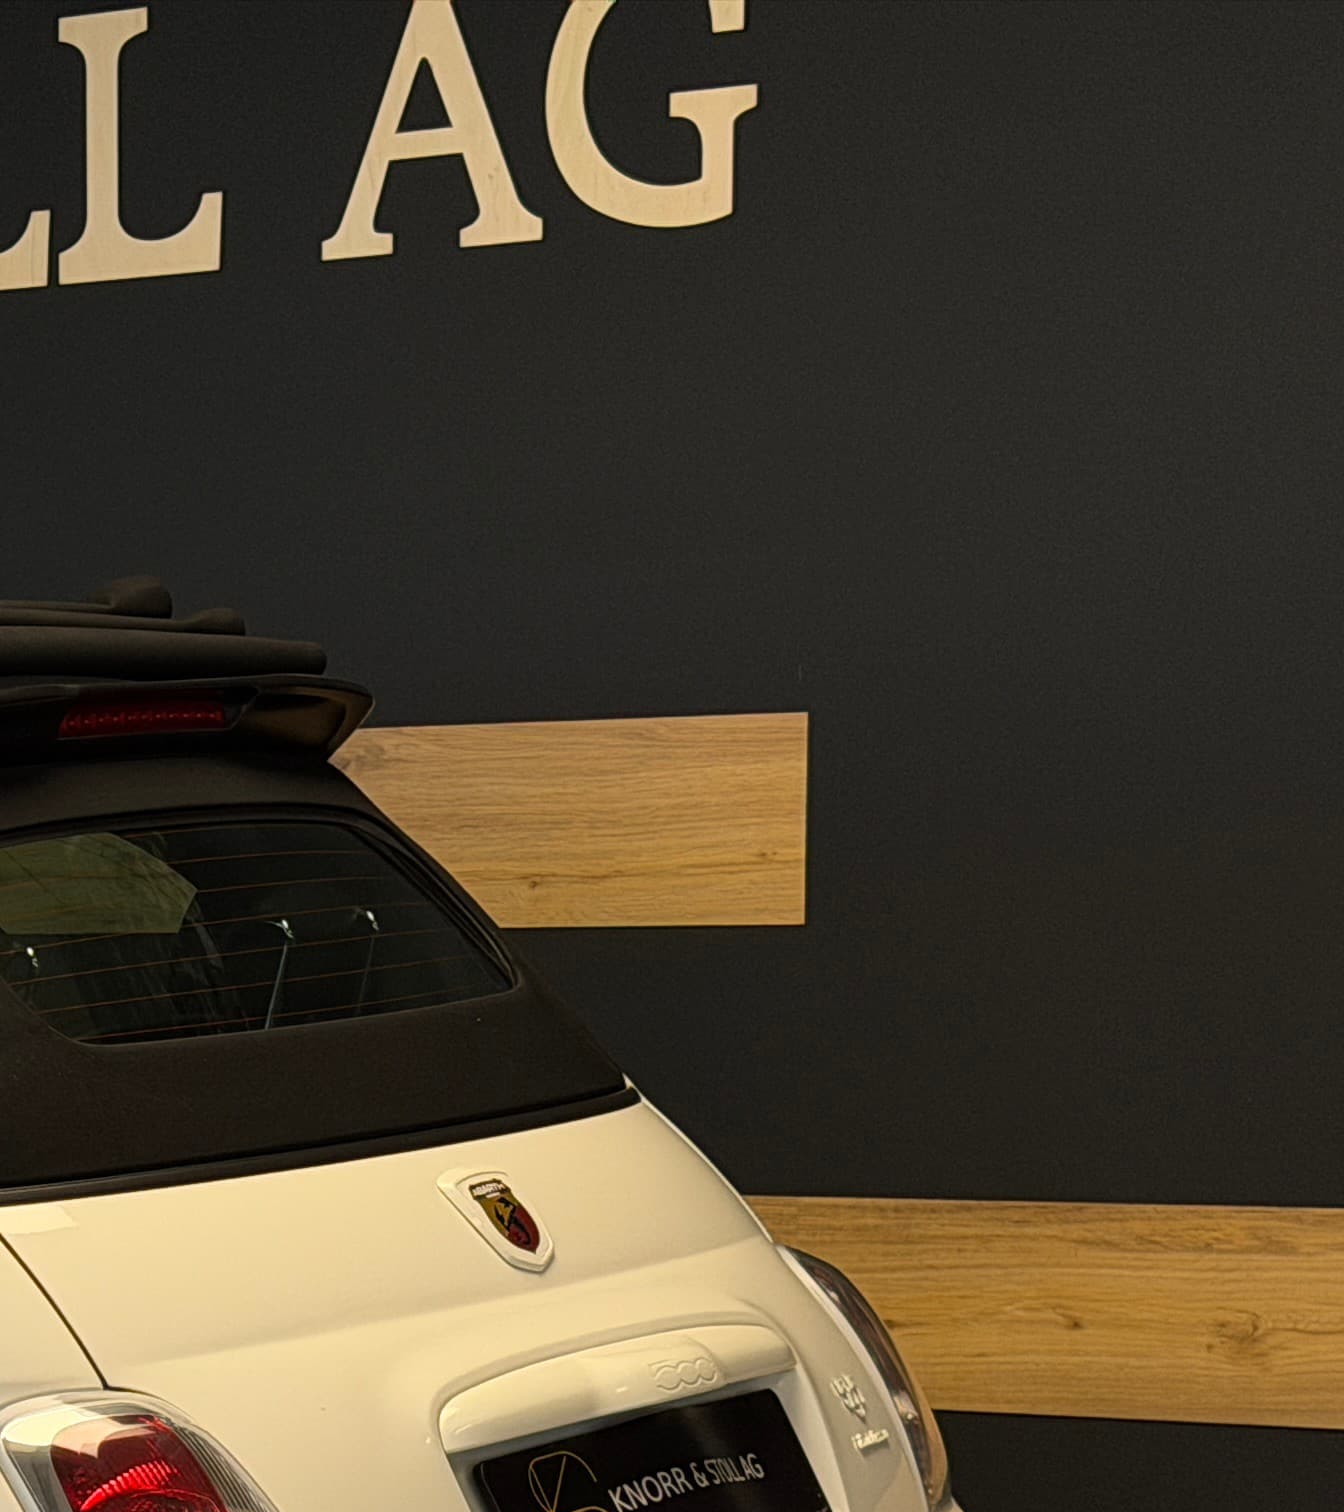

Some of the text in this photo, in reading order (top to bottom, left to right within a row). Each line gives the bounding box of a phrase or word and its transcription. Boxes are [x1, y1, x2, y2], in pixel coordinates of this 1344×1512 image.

[321, 0, 758, 261] AG
[689, 1462, 710, 1488] &
[704, 1457, 745, 1485] STOLL
[739, 1453, 765, 1481] AG
